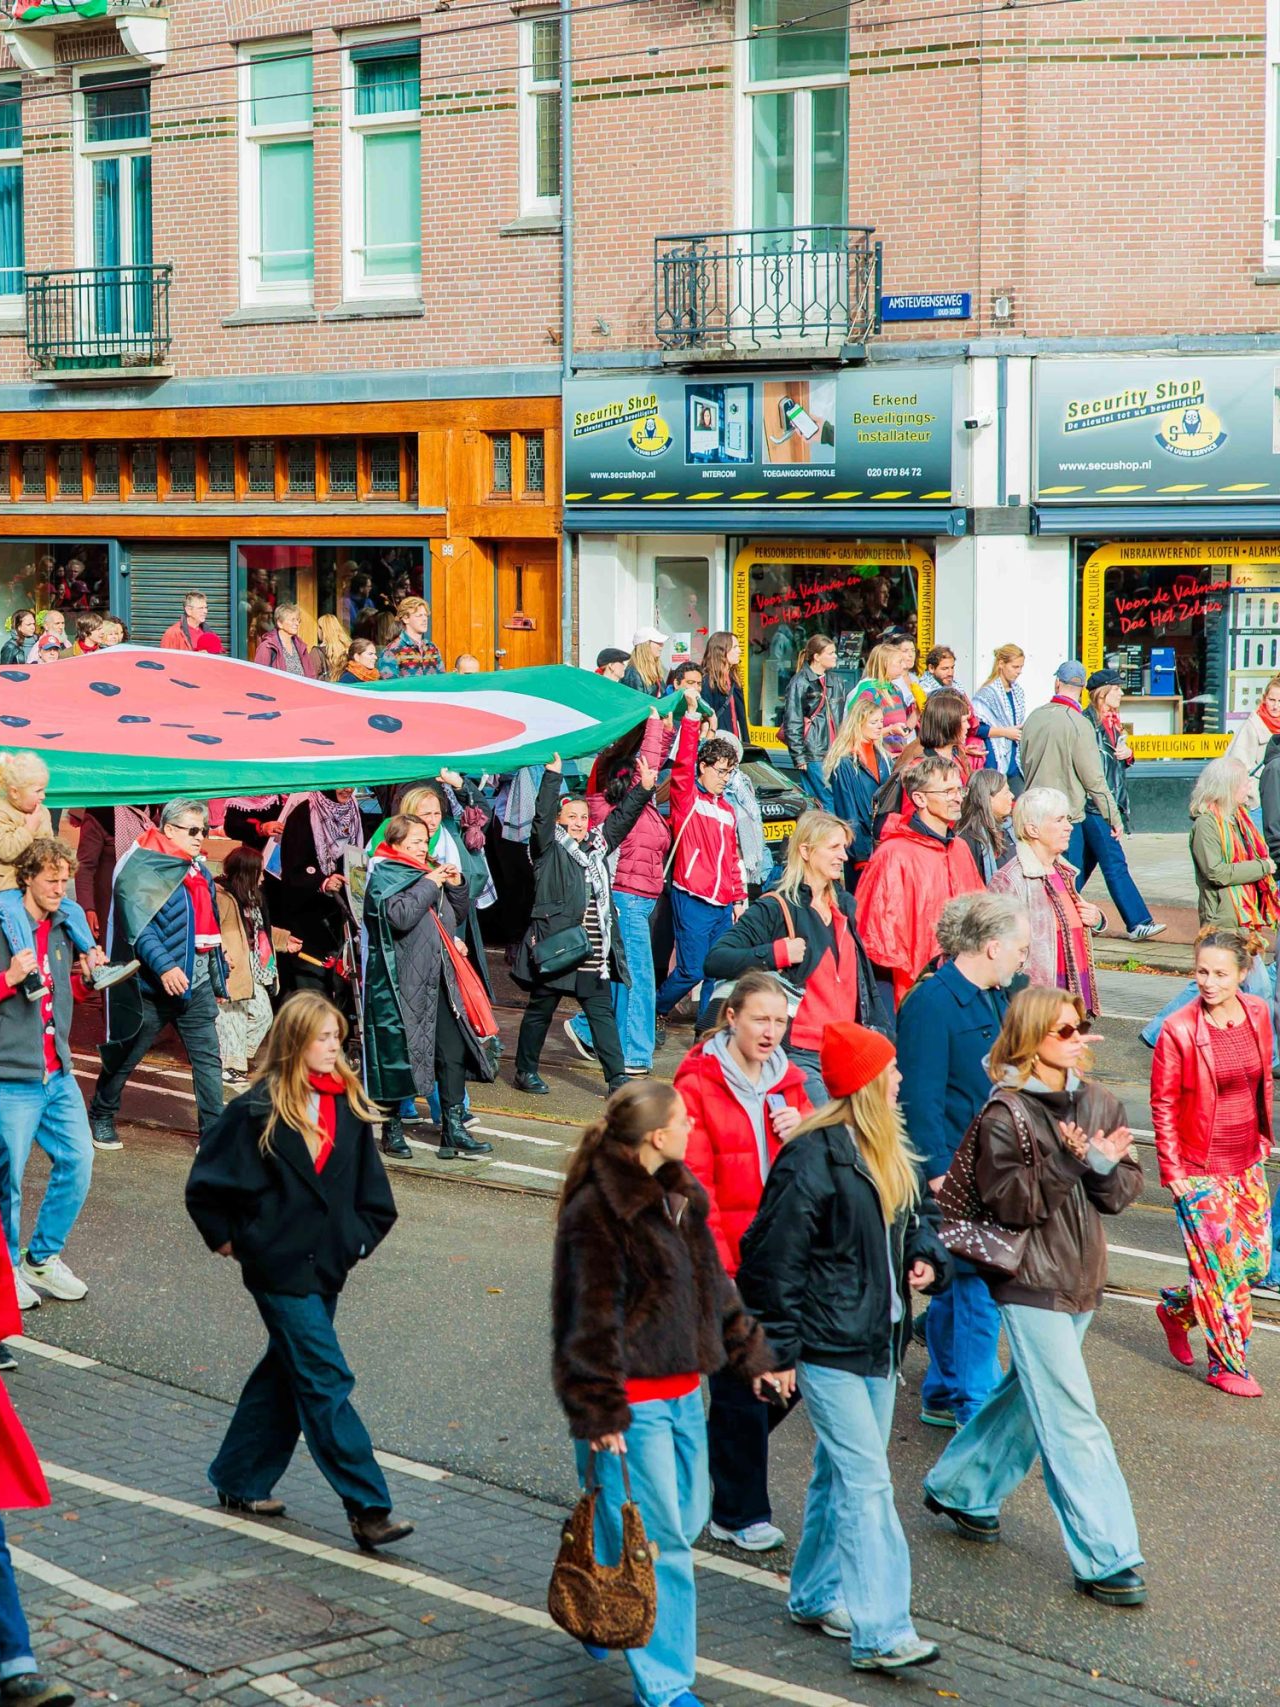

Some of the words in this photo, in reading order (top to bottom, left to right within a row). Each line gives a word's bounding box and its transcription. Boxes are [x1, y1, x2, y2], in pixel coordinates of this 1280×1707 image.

[888, 294, 963, 309] AMSTELVEENSEWEG
[873, 394, 917, 406] Erkend
[1068, 390, 1148, 417] Security
[1156, 379, 1201, 398] Shop
[575, 402, 624, 426] Security
[628, 394, 657, 410] Shop
[1067, 422, 1079, 430] De
[1117, 411, 1131, 420] tot
[1134, 407, 1147, 416] uw
[1150, 396, 1202, 413] beveiliging
[854, 412, 936, 426] Beveiligings-
[858, 430, 931, 442] installateur
[867, 468, 882, 477] 020
[883, 468, 898, 477] 679
[899, 468, 910, 477] 84
[912, 468, 922, 477] 72
[1059, 460, 1152, 471] www.secushop.nl
[590, 470, 656, 480] www.secushop.nl
[702, 470, 737, 478] INTERCOM
[763, 469, 836, 478] TOEGANGSCONTROLE
[754, 547, 831, 559] PERSOONSBEVEILIGING
[1120, 547, 1201, 560] INBRAAKWERENDE
[1207, 546, 1240, 558] SLOTEN
[737, 571, 745, 611] SYSTEMEN
[1088, 562, 1100, 610] ROLLUIKEN
[756, 594, 782, 610] Voor
[784, 584, 797, 600] de
[1115, 597, 1150, 614] Voor
[1152, 587, 1170, 603] de
[1173, 580, 1231, 601] Vakman
[922, 559, 932, 664] COMMUNICATIESYSTEM
[1120, 616, 1146, 635] Doe
[1150, 607, 1175, 627] Het
[1088, 619, 1100, 669] AUTOALARM
[1126, 740, 1195, 752] AKBEVEILIGING
[1200, 740, 1209, 751] IN
[1213, 739, 1229, 751] WO
